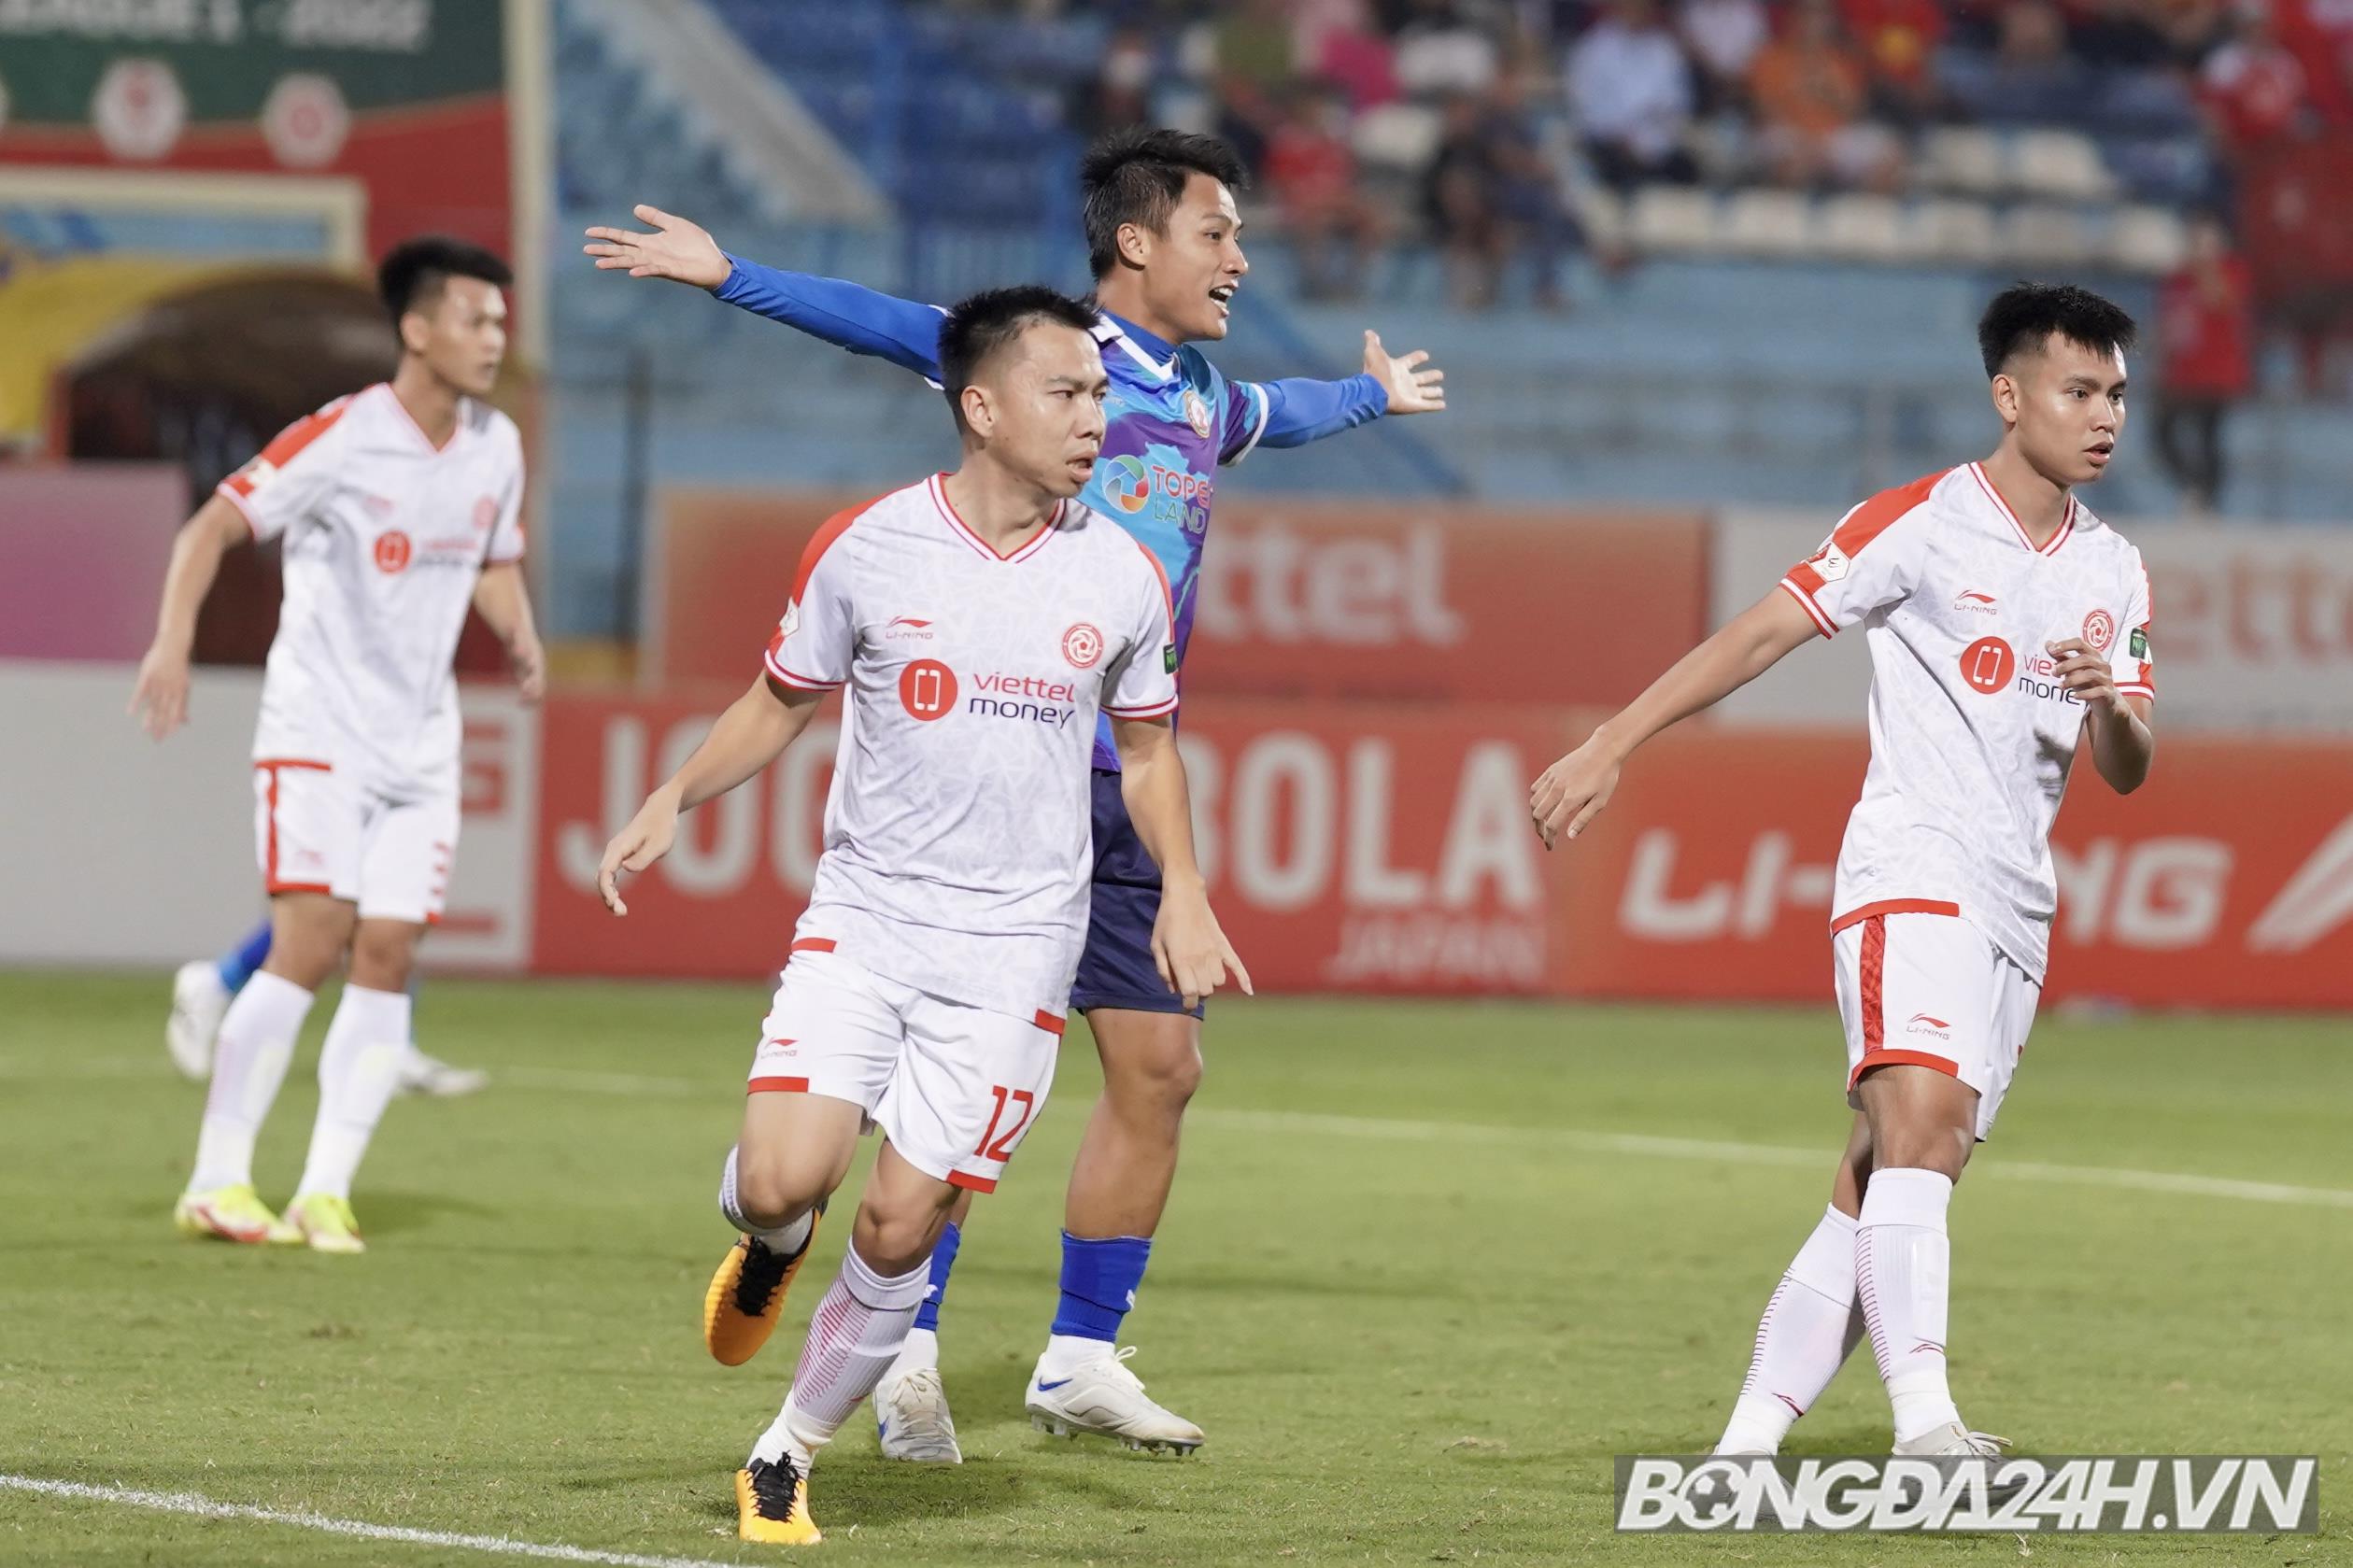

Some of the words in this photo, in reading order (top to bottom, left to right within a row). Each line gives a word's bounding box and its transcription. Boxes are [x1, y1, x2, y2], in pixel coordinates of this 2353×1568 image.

[1152, 465, 1211, 509] TOPE
[1155, 496, 1207, 534] LAND
[1954, 603, 1997, 615] LI-NING
[885, 631, 933, 640] LI-NING
[2024, 654, 2053, 676] vie
[972, 671, 1075, 702] viettel
[2019, 677, 2090, 712] mone
[970, 698, 1075, 729] money
[1906, 1025, 1949, 1040] LI-NING
[973, 1084, 1034, 1163] 12
